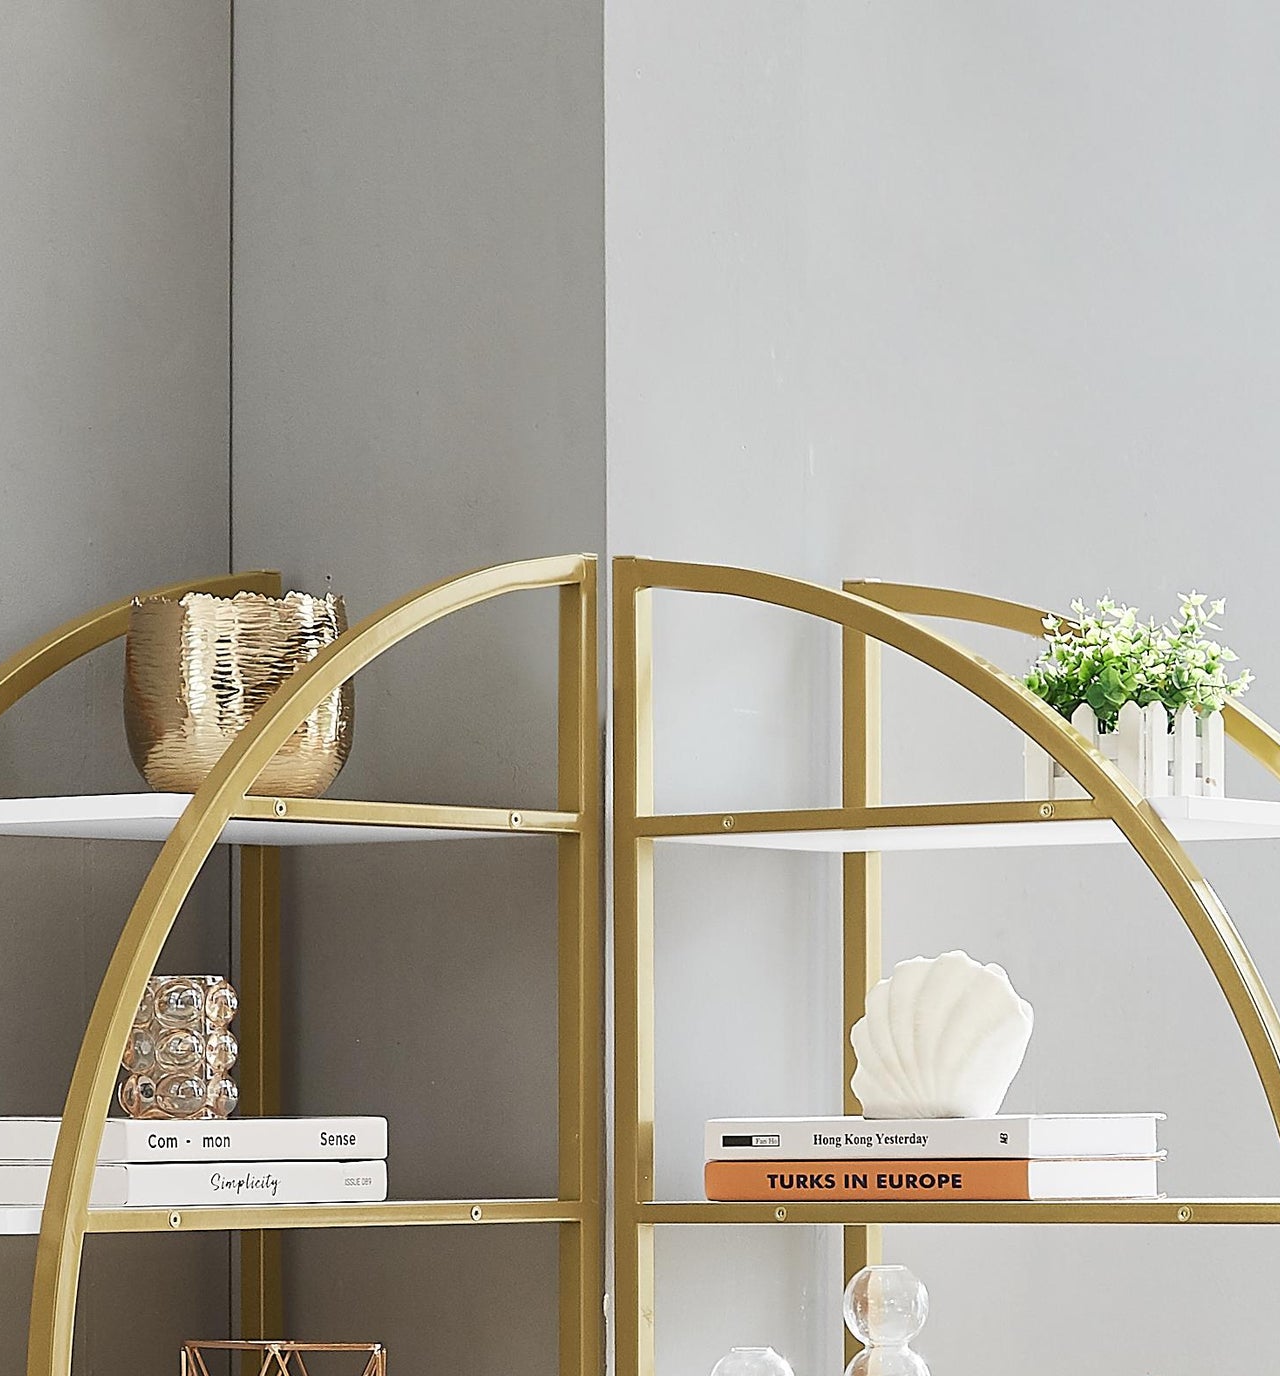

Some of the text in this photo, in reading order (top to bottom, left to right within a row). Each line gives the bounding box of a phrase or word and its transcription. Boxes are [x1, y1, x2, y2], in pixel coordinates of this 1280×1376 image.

[147, 1133, 178, 1149] Com
[202, 1135, 231, 1149] mon
[320, 1131, 357, 1147] Sense
[813, 1132, 929, 1149] Hong Kong Yesterday
[210, 1172, 281, 1196] Simplicity
[766, 1173, 963, 1190] TURKS IN EUROPE
